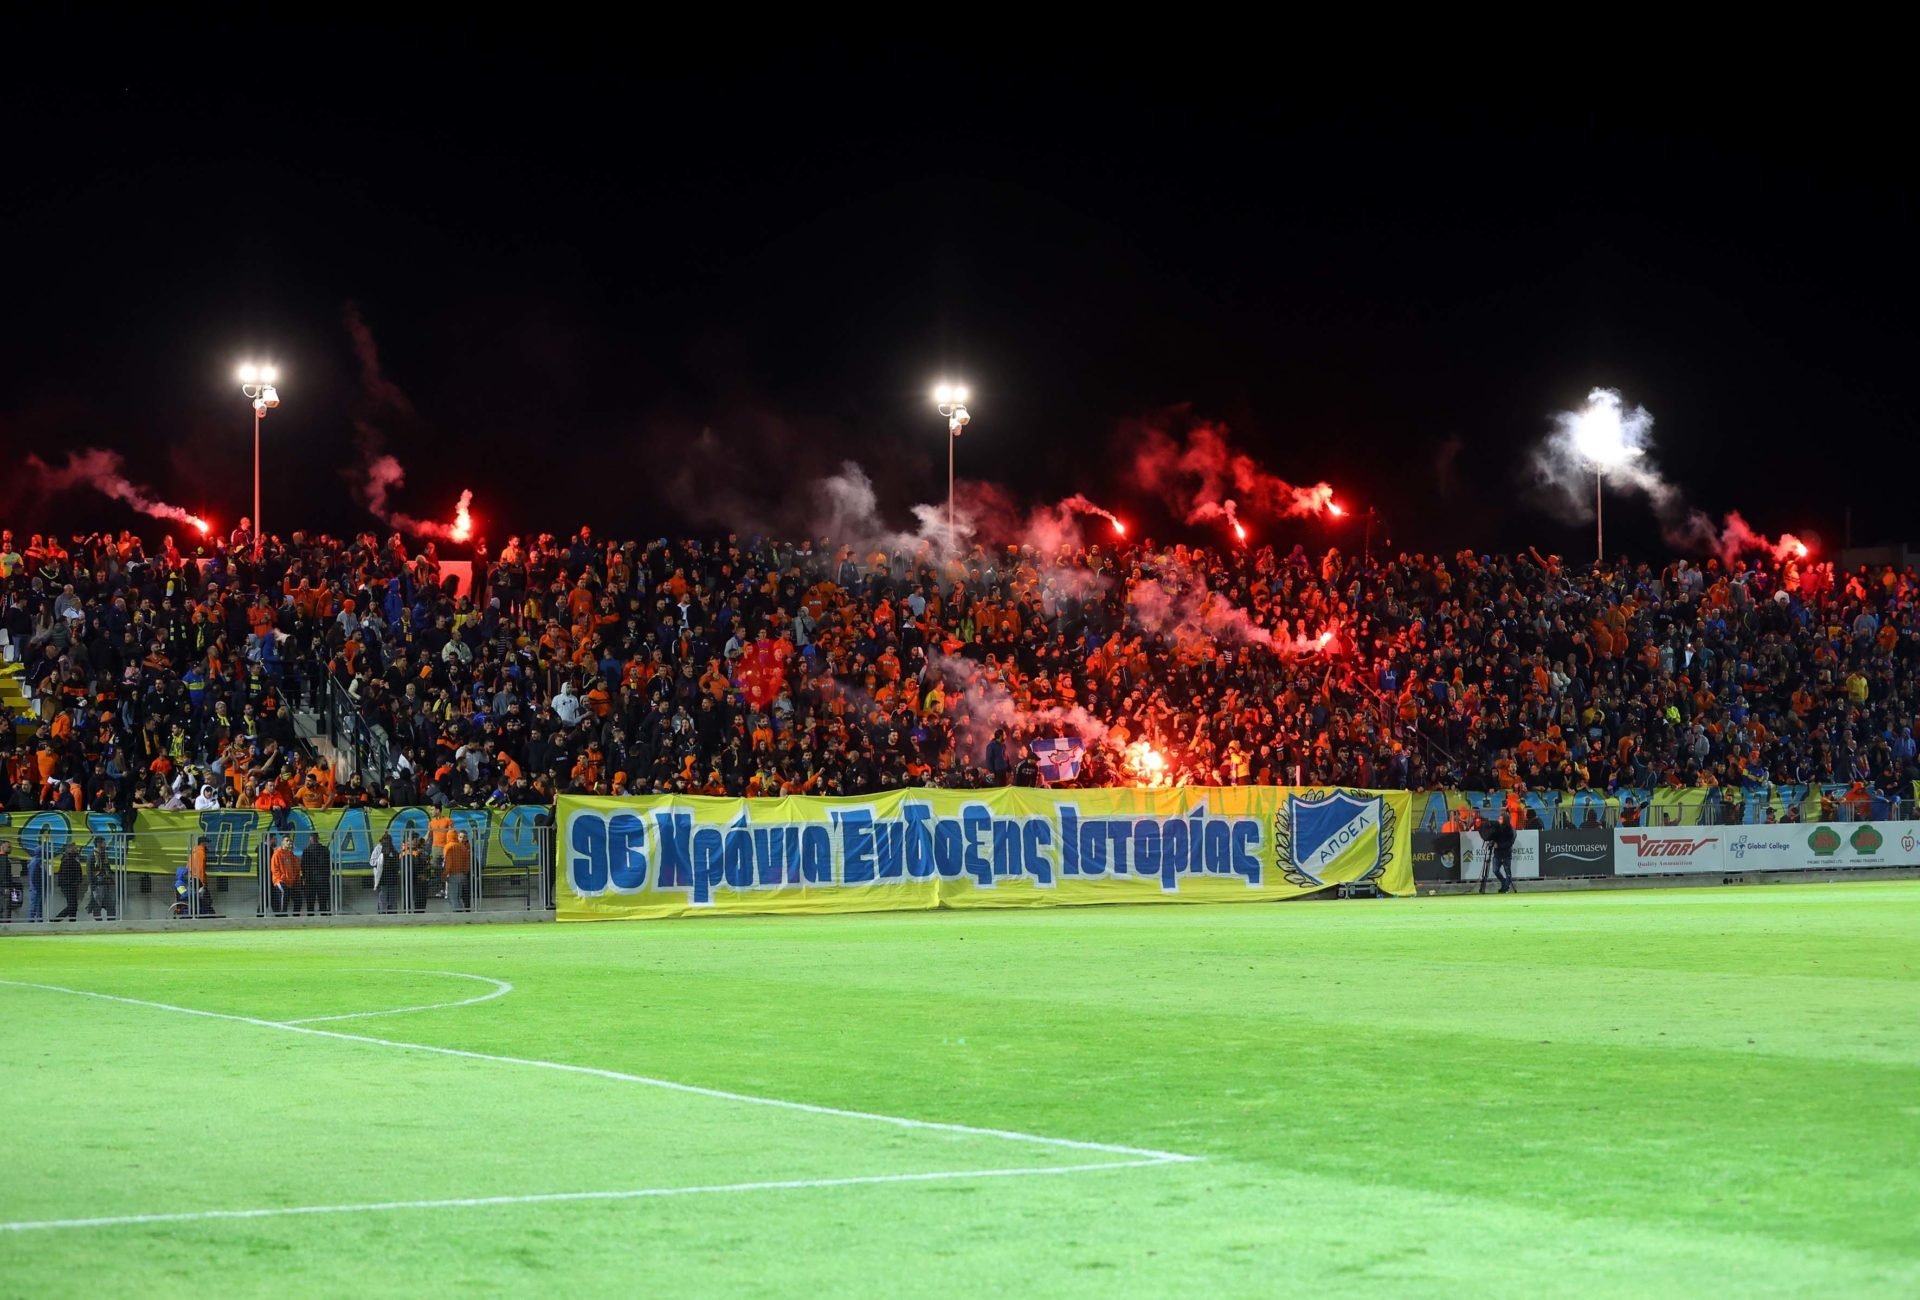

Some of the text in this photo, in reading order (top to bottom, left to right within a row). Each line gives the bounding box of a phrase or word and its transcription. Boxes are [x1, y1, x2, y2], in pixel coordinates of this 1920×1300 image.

[571, 804, 1262, 903] 96 Χρόνια Ένδοξης Ιστορίας
[1320, 816, 1370, 864] ΑΠΟΕΛ
[1544, 842, 1608, 853] Panstromasew
[1747, 842, 1790, 851] Global College
